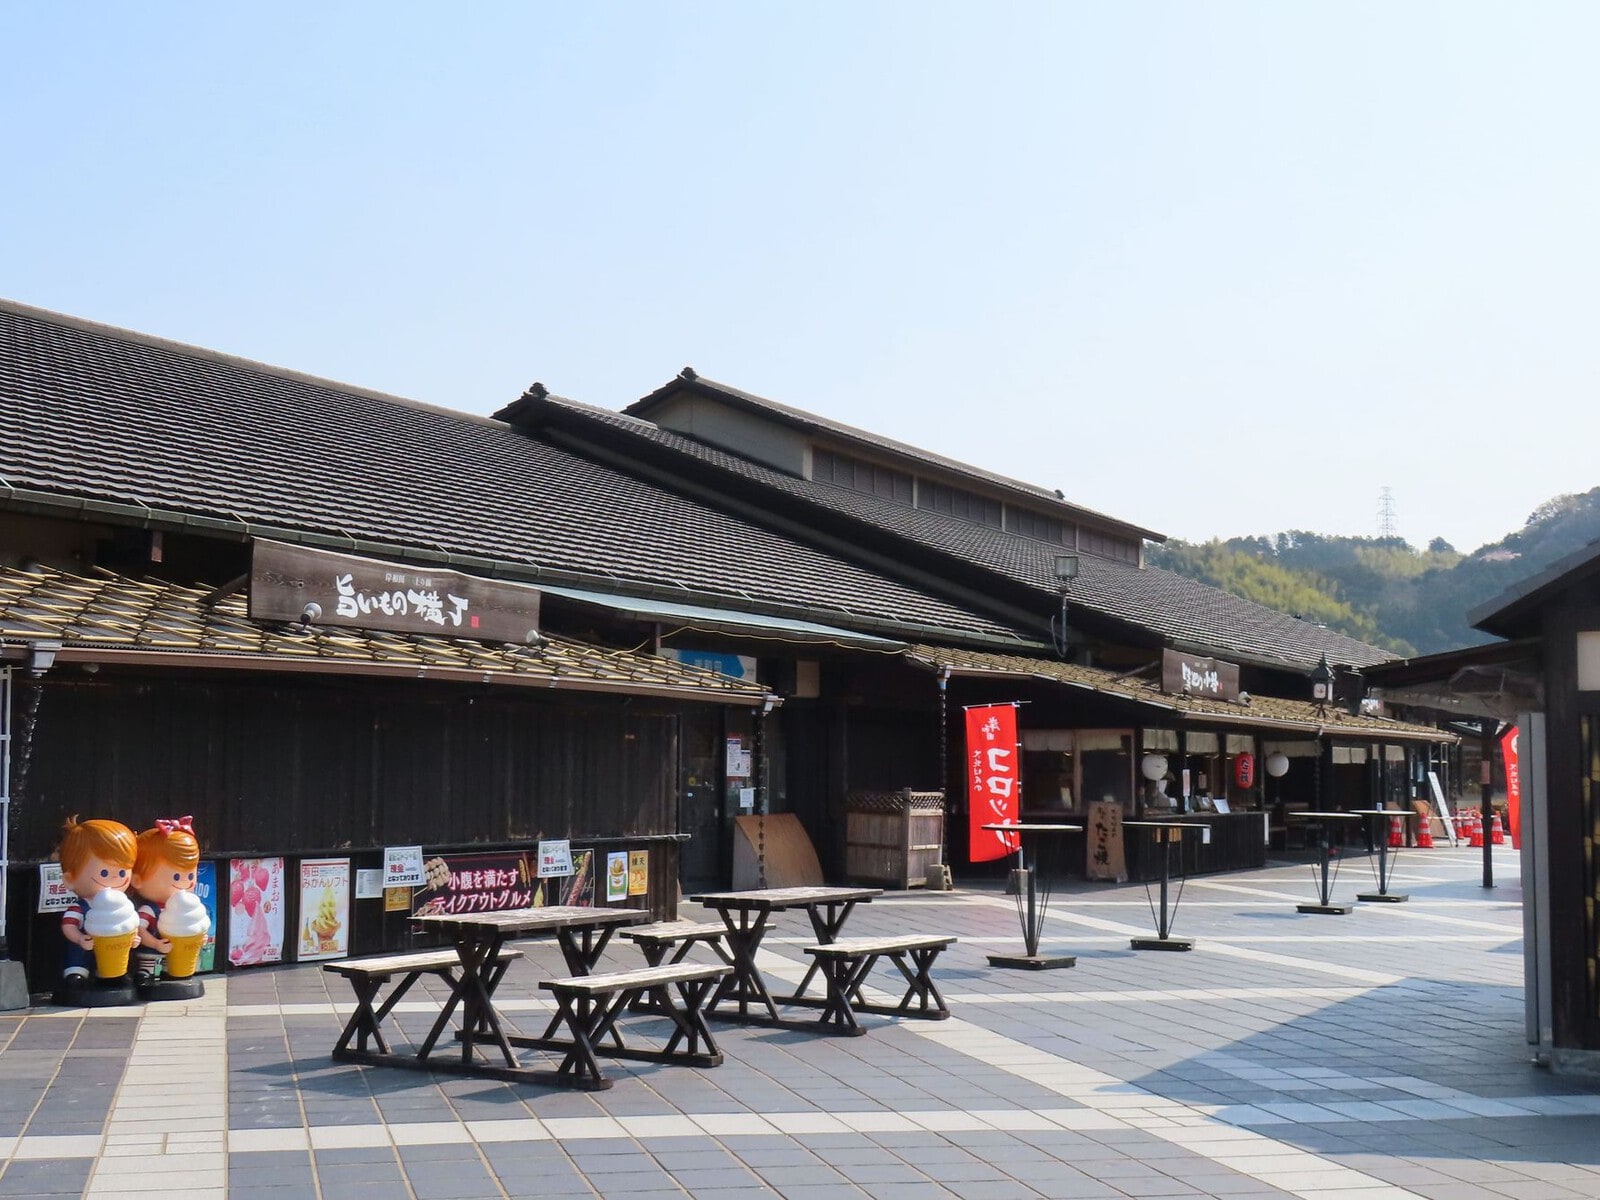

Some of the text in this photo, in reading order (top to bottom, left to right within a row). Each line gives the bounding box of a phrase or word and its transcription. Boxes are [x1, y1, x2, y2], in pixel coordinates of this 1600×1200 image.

[336, 573, 469, 627] 旨いもの横丁
[448, 868, 519, 890] 小腹を満たす
[434, 890, 532, 914] テイクアウトグルメ
